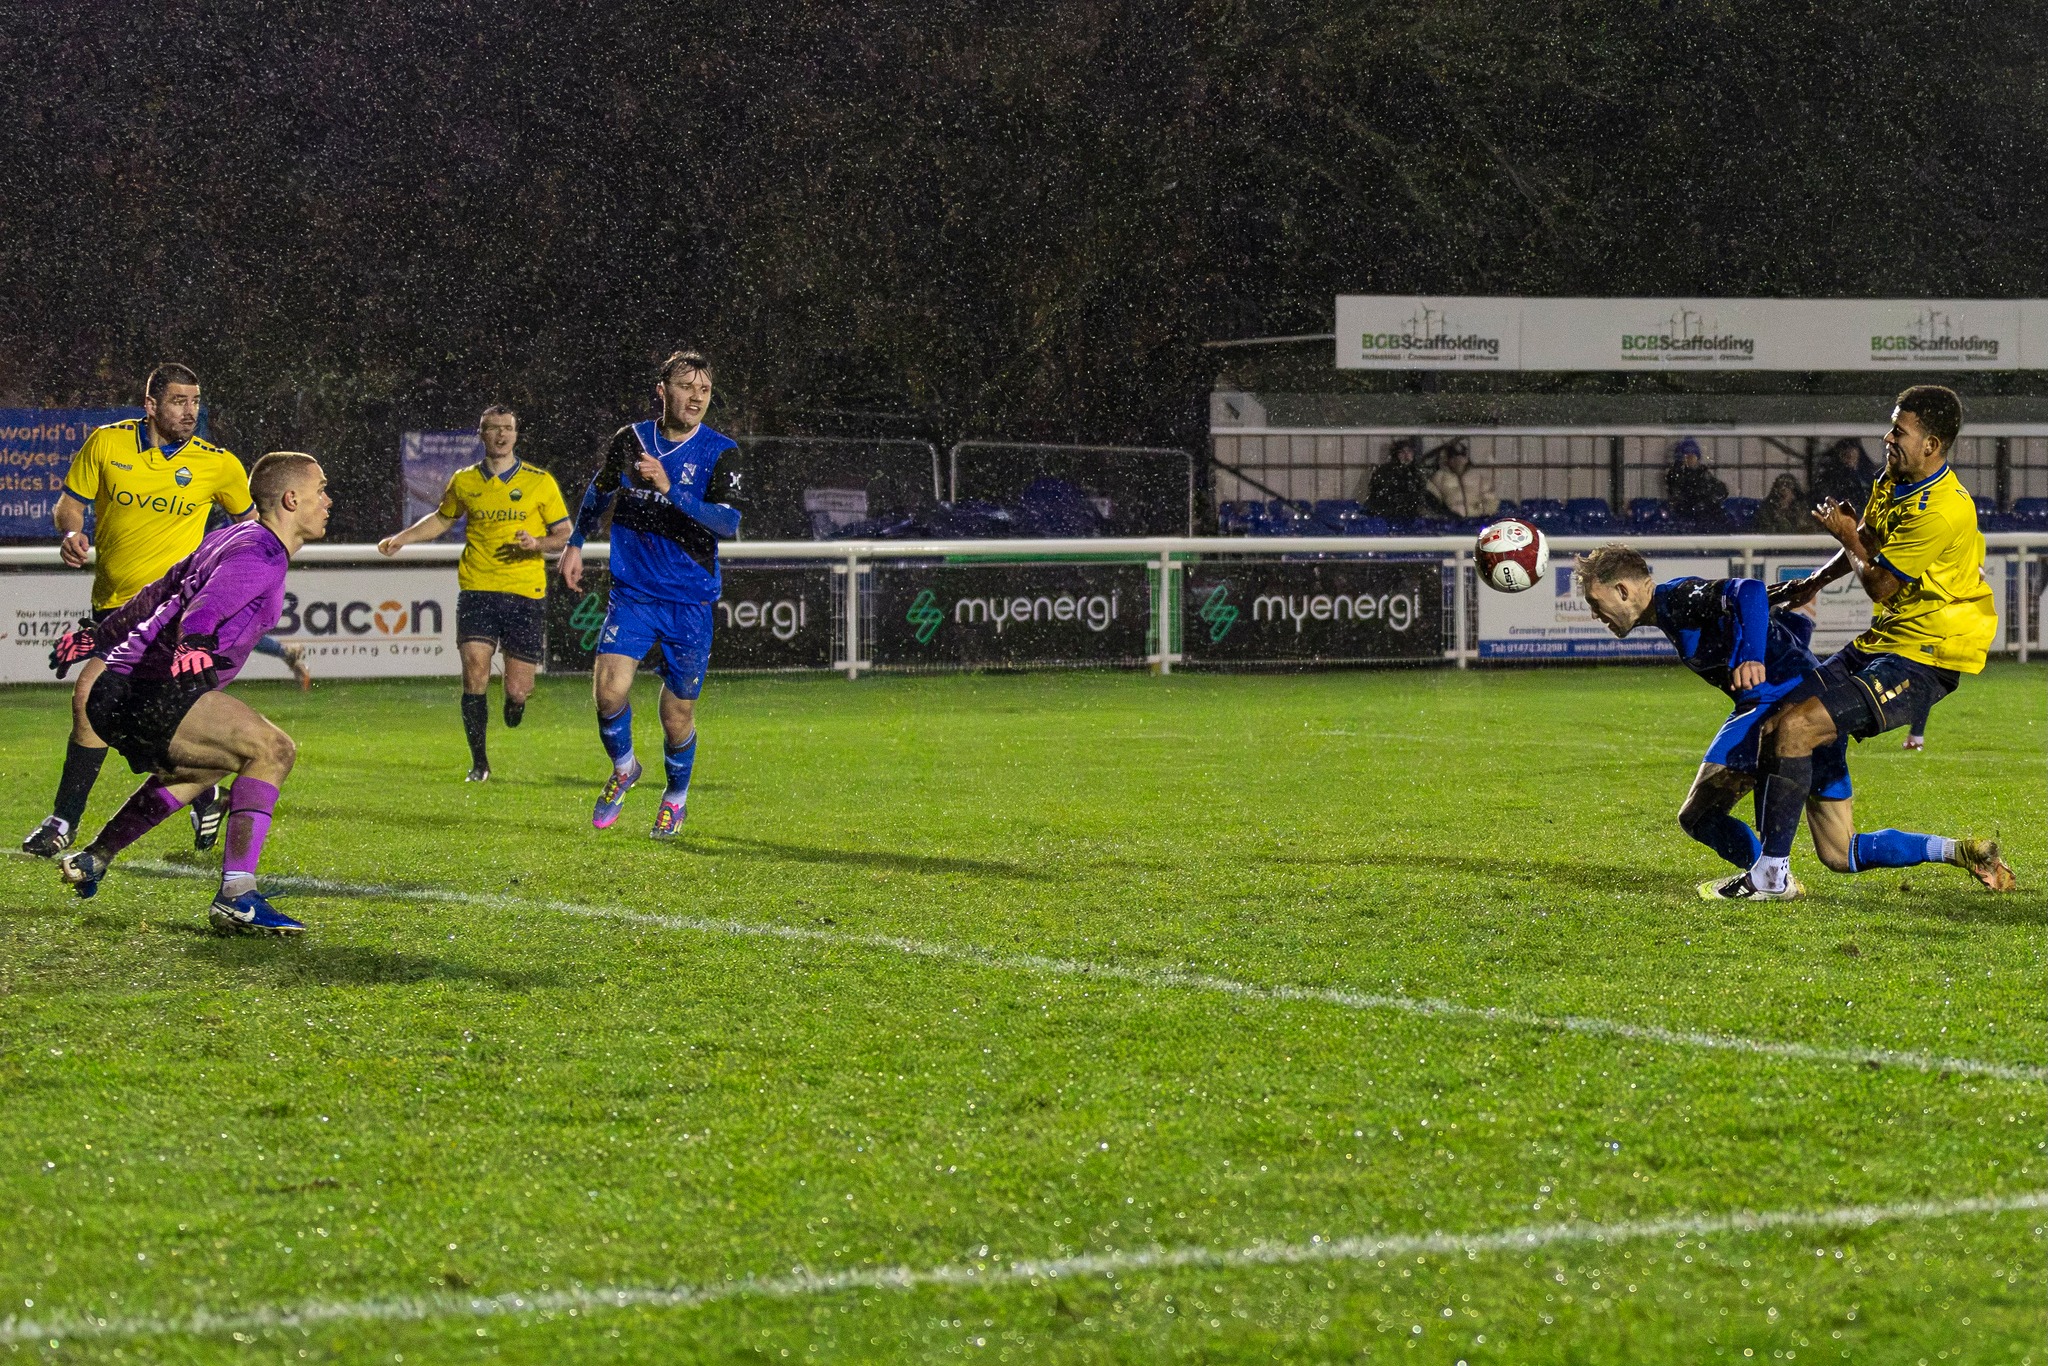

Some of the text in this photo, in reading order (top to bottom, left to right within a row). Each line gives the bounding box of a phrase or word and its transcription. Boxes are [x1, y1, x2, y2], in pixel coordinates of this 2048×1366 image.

[109, 483, 197, 516] lovelis
[274, 592, 443, 636] Bacon
[955, 589, 1118, 633] myenergi
[1253, 588, 1421, 632] myenergi
